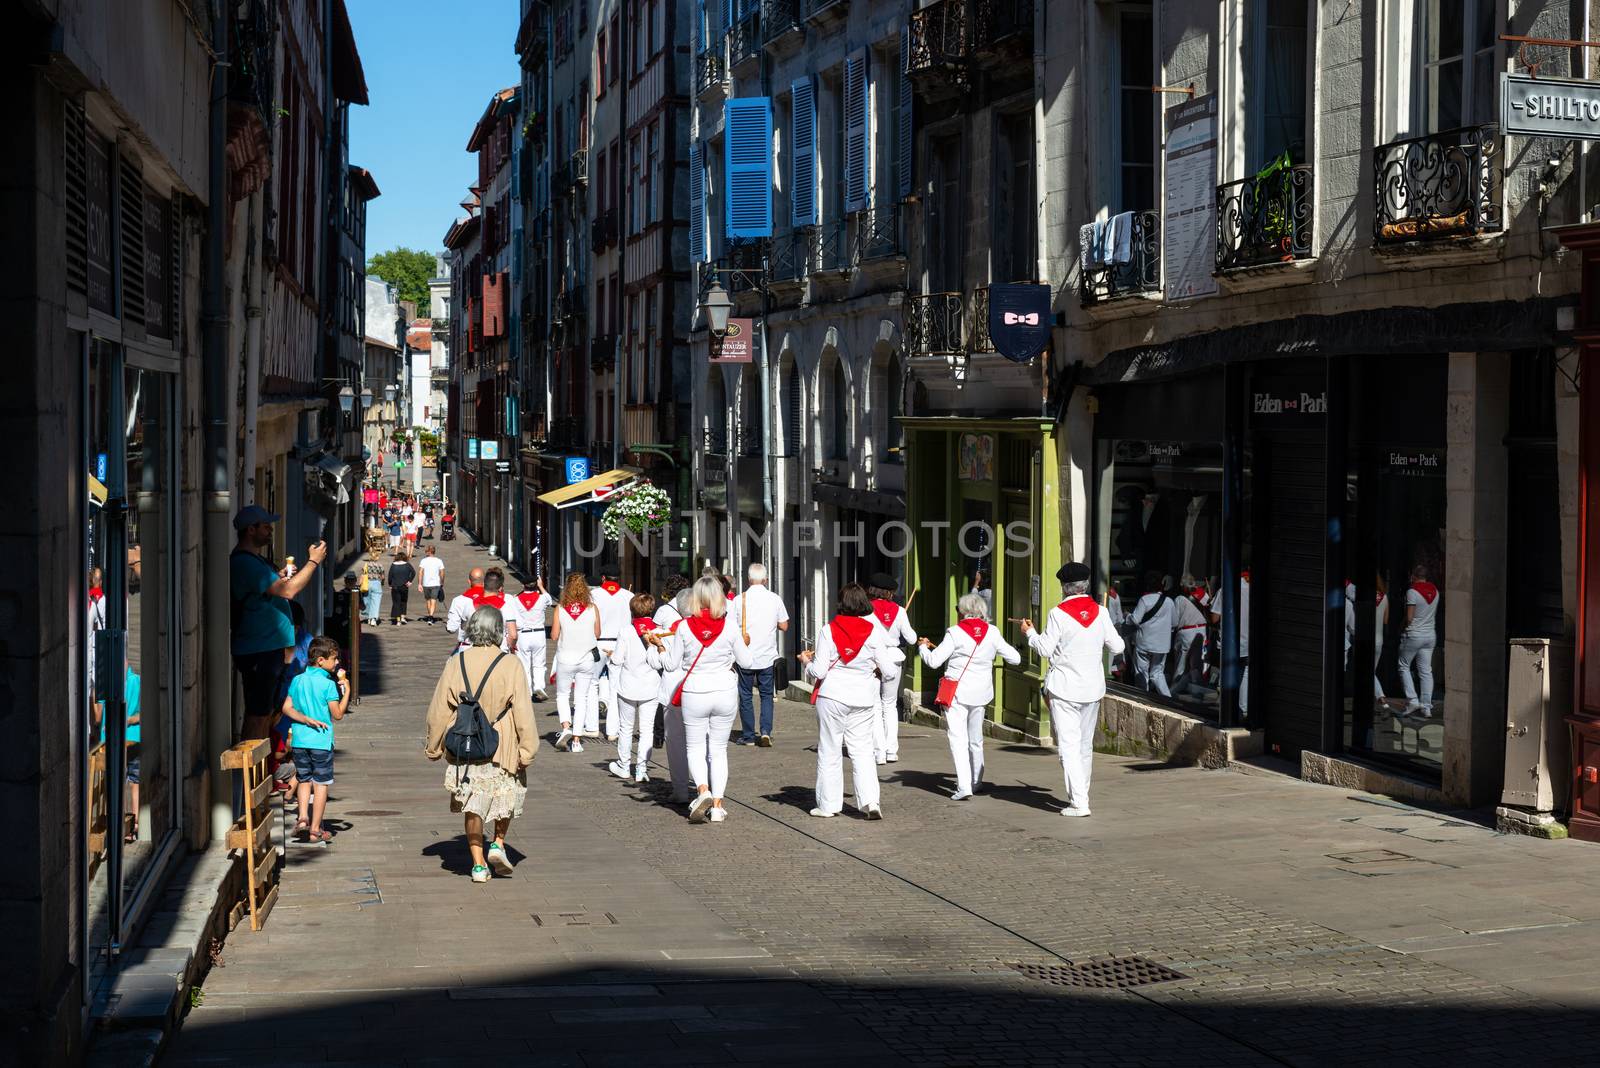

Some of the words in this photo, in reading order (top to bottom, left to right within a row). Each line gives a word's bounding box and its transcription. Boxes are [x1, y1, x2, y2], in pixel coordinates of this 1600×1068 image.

[1253, 392, 1282, 413] Eden
[1300, 391, 1328, 413] Park
[1390, 452, 1408, 465] Eden
[1419, 453, 1438, 467] Park
